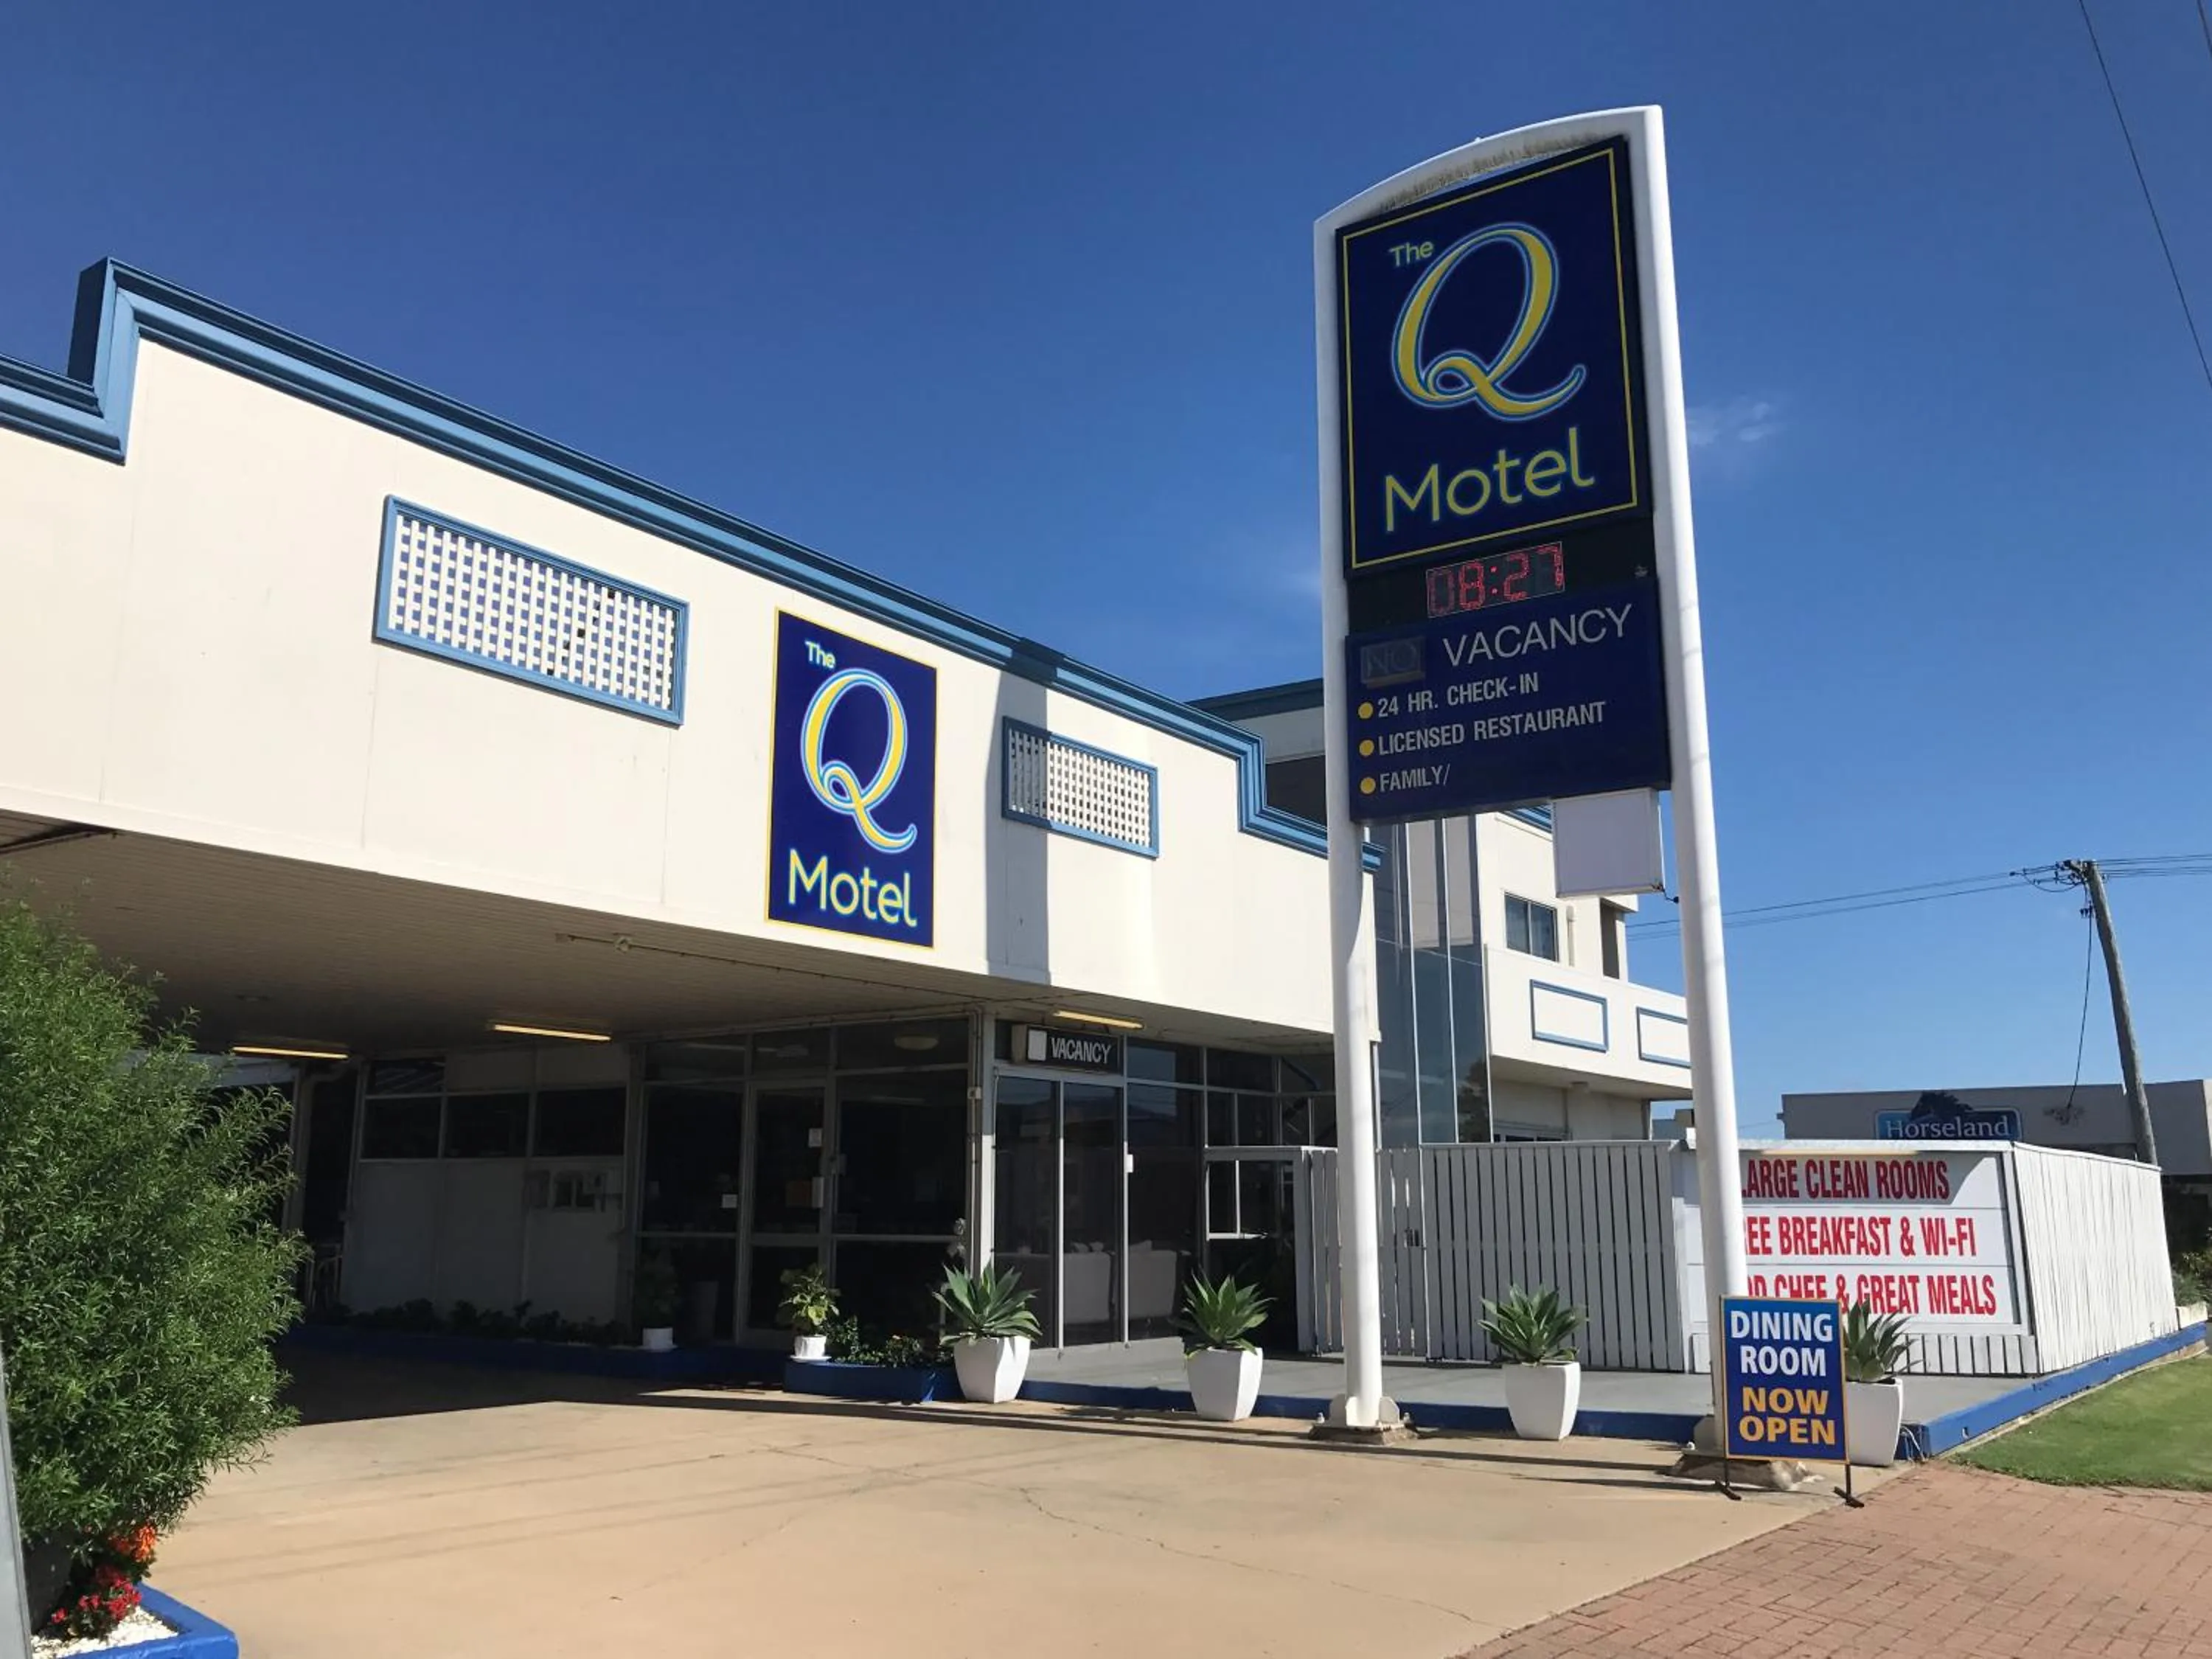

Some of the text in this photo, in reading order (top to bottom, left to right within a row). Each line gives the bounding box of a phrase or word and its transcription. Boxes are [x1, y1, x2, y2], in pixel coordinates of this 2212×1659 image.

[1389, 239, 1434, 267] The
[1391, 221, 1587, 421] Q
[1385, 427, 1596, 534] Motel
[1427, 543, 1563, 616] 08:27
[804, 640, 836, 669] The
[1443, 603, 1632, 667] VACANCY
[1377, 672, 1539, 718] 24 HR. CHECK-IN
[1378, 701, 1605, 756] LICENSED RESTAURANT
[800, 667, 917, 853] Q
[1380, 764, 1450, 793] FAMILY/
[788, 848, 917, 927] Motel
[1051, 1037, 1111, 1064] VACANCY
[1885, 1115, 2011, 1138] Horseland
[1742, 1159, 1950, 1199] ARGE CLEAN ROOMS
[1745, 1217, 1976, 1256] EE BREAKFAST & WI-FI
[1857, 1274, 1919, 1315] GREAT
[1927, 1274, 1996, 1315] MEALS
[1731, 1310, 1833, 1342] DINING
[1740, 1345, 1826, 1377] ROOM
[1742, 1385, 1829, 1415] NOW
[1739, 1415, 1835, 1445] OPEN
